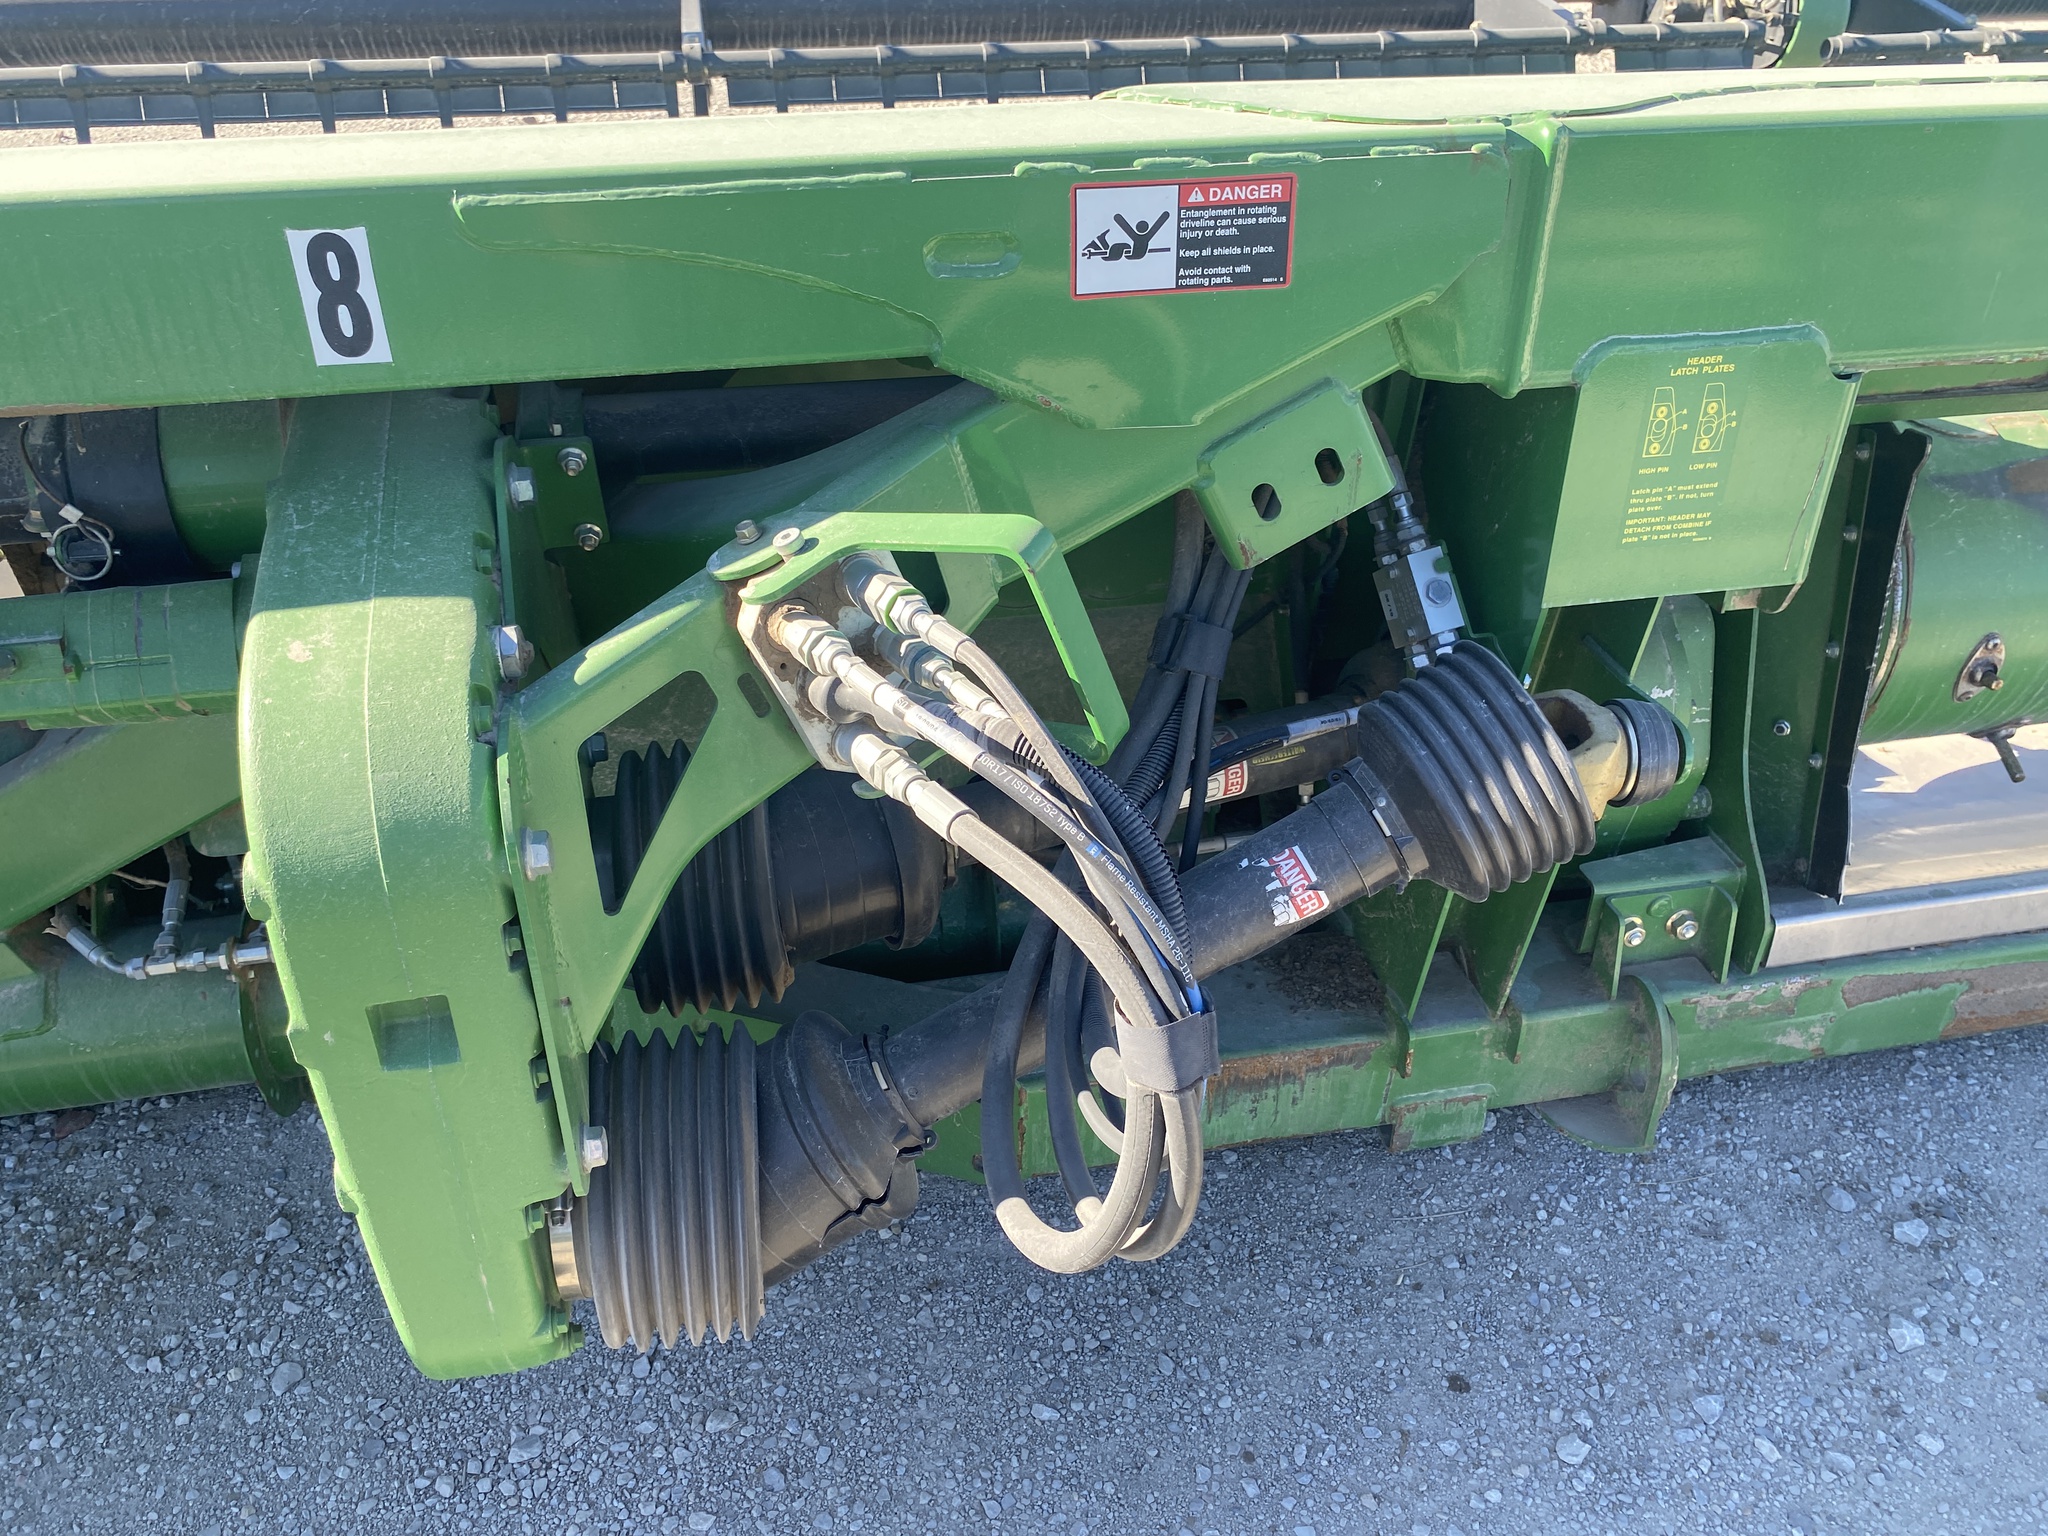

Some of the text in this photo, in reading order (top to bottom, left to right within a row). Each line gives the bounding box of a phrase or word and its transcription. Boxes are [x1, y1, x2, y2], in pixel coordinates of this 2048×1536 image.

[1209, 184, 1282, 201] DANGER
[1180, 205, 1277, 219] Entanglement in rotating
[1180, 215, 1287, 228] driveline can cause serious
[1180, 229, 1203, 240] injury
[1215, 227, 1240, 236] death.
[1179, 245, 1275, 258] Keep all shields in place.
[1179, 264, 1251, 276] Avoid contact with
[1179, 275, 1233, 286] rotating parts.
[306, 232, 374, 358] 8
[1687, 355, 1723, 365] HEADER
[1670, 364, 1735, 377] LATCH PLATES
[1638, 467, 1656, 475] HIGH
[1689, 463, 1705, 471] LOW
[1631, 487, 1651, 495] Latch
[1652, 487, 1663, 495] pin
[1695, 482, 1719, 490] extend
[1645, 496, 1663, 505] plate
[1627, 506, 1645, 515] plate
[1625, 516, 1666, 526] IMPORTANT:
[1667, 513, 1696, 522] HEADER
[1623, 525, 1651, 534] DETACH
[1652, 523, 1672, 531] FROM
[1673, 521, 1704, 530] COMBINE
[1622, 536, 1639, 544] plate
[1679, 531, 1698, 539] place.
[1010, 778, 1029, 794] ISO
[1027, 790, 1059, 818] 18752
[1057, 814, 1078, 835] Type
[1076, 831, 1086, 842] B
[1100, 854, 1127, 883] Flame
[1124, 879, 1159, 922] Resistant
[1156, 919, 1176, 949] MSHA
[1272, 848, 1319, 916] DANGER
